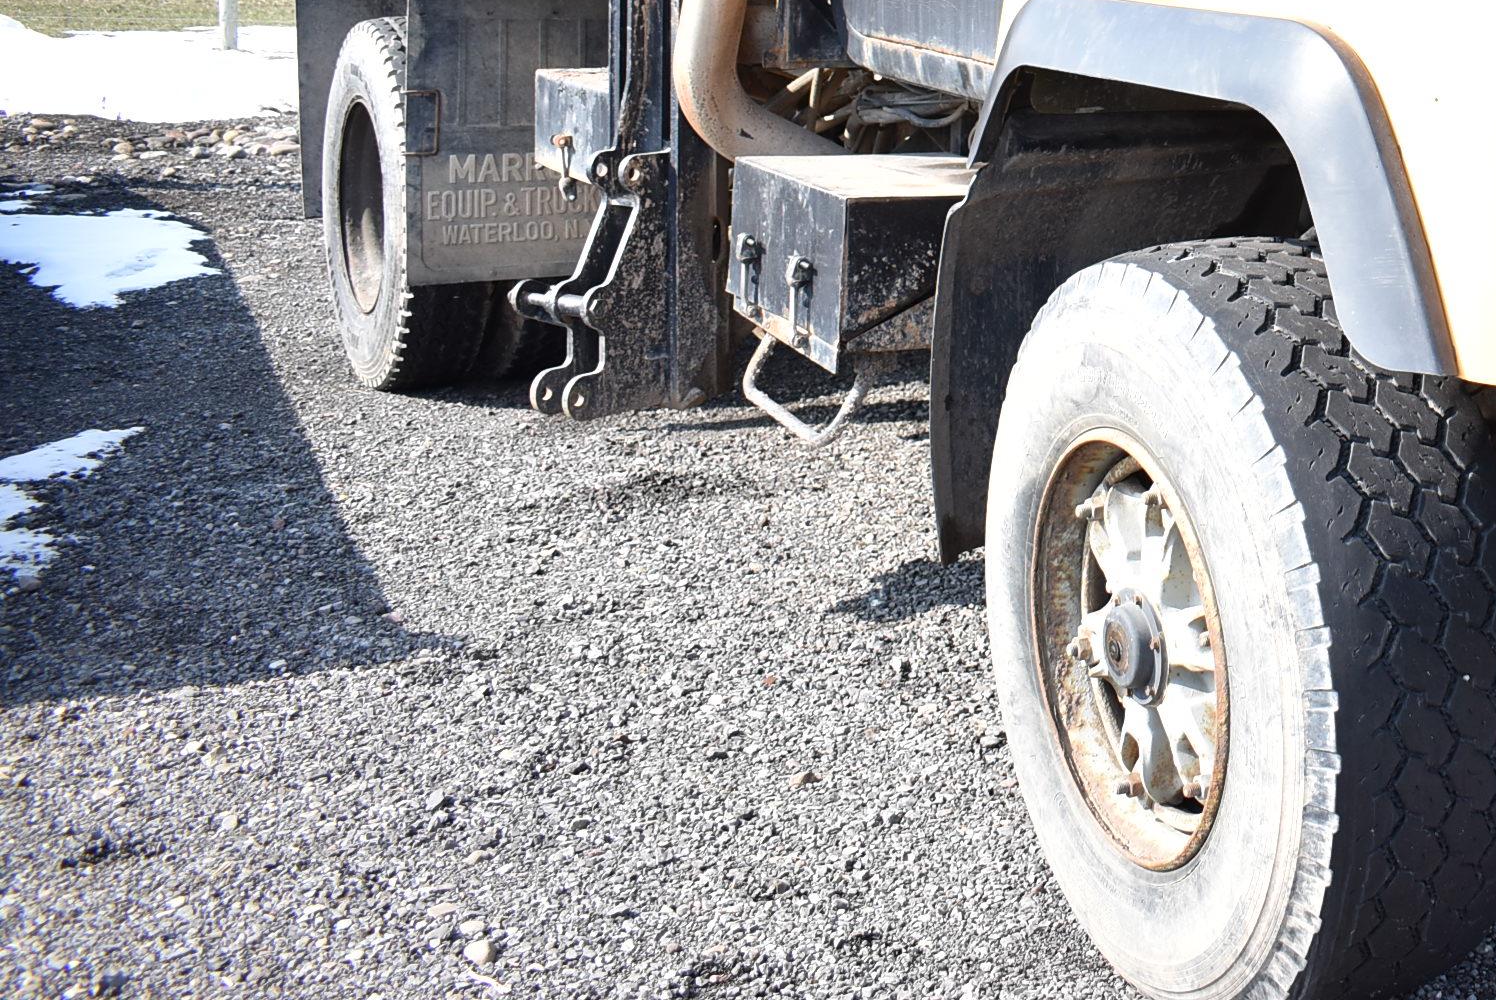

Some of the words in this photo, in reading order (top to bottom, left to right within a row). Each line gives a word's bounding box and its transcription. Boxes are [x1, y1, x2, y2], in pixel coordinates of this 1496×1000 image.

[448, 152, 562, 184] MARR
[427, 189, 498, 222] EQUIP.
[503, 191, 521, 217] &
[444, 221, 561, 245] WATERLOO,
